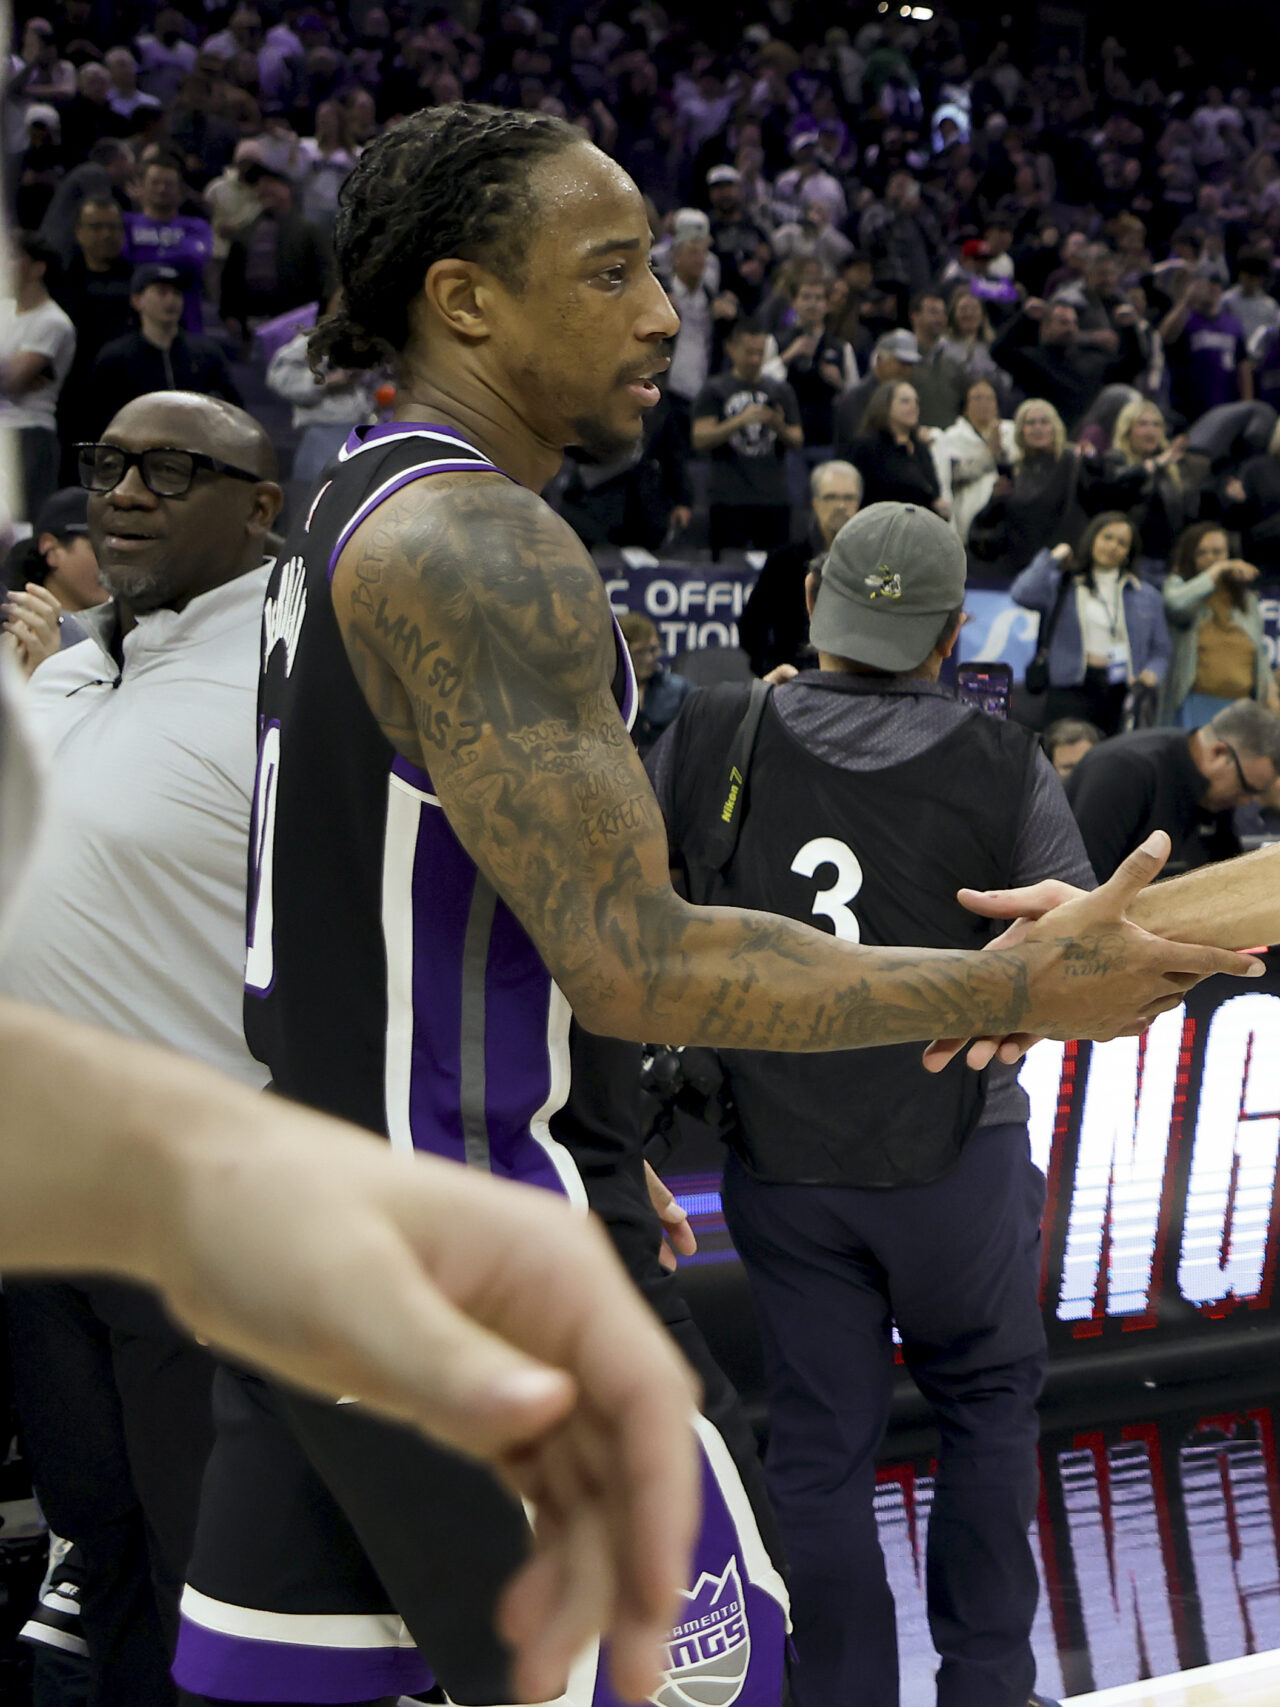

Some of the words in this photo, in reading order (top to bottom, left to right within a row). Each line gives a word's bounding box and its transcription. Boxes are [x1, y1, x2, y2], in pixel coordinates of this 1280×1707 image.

[644, 579, 755, 617] OFFI
[721, 784, 740, 823] Nikon
[790, 836, 864, 945] 3
[667, 1601, 739, 1638] AMENTO
